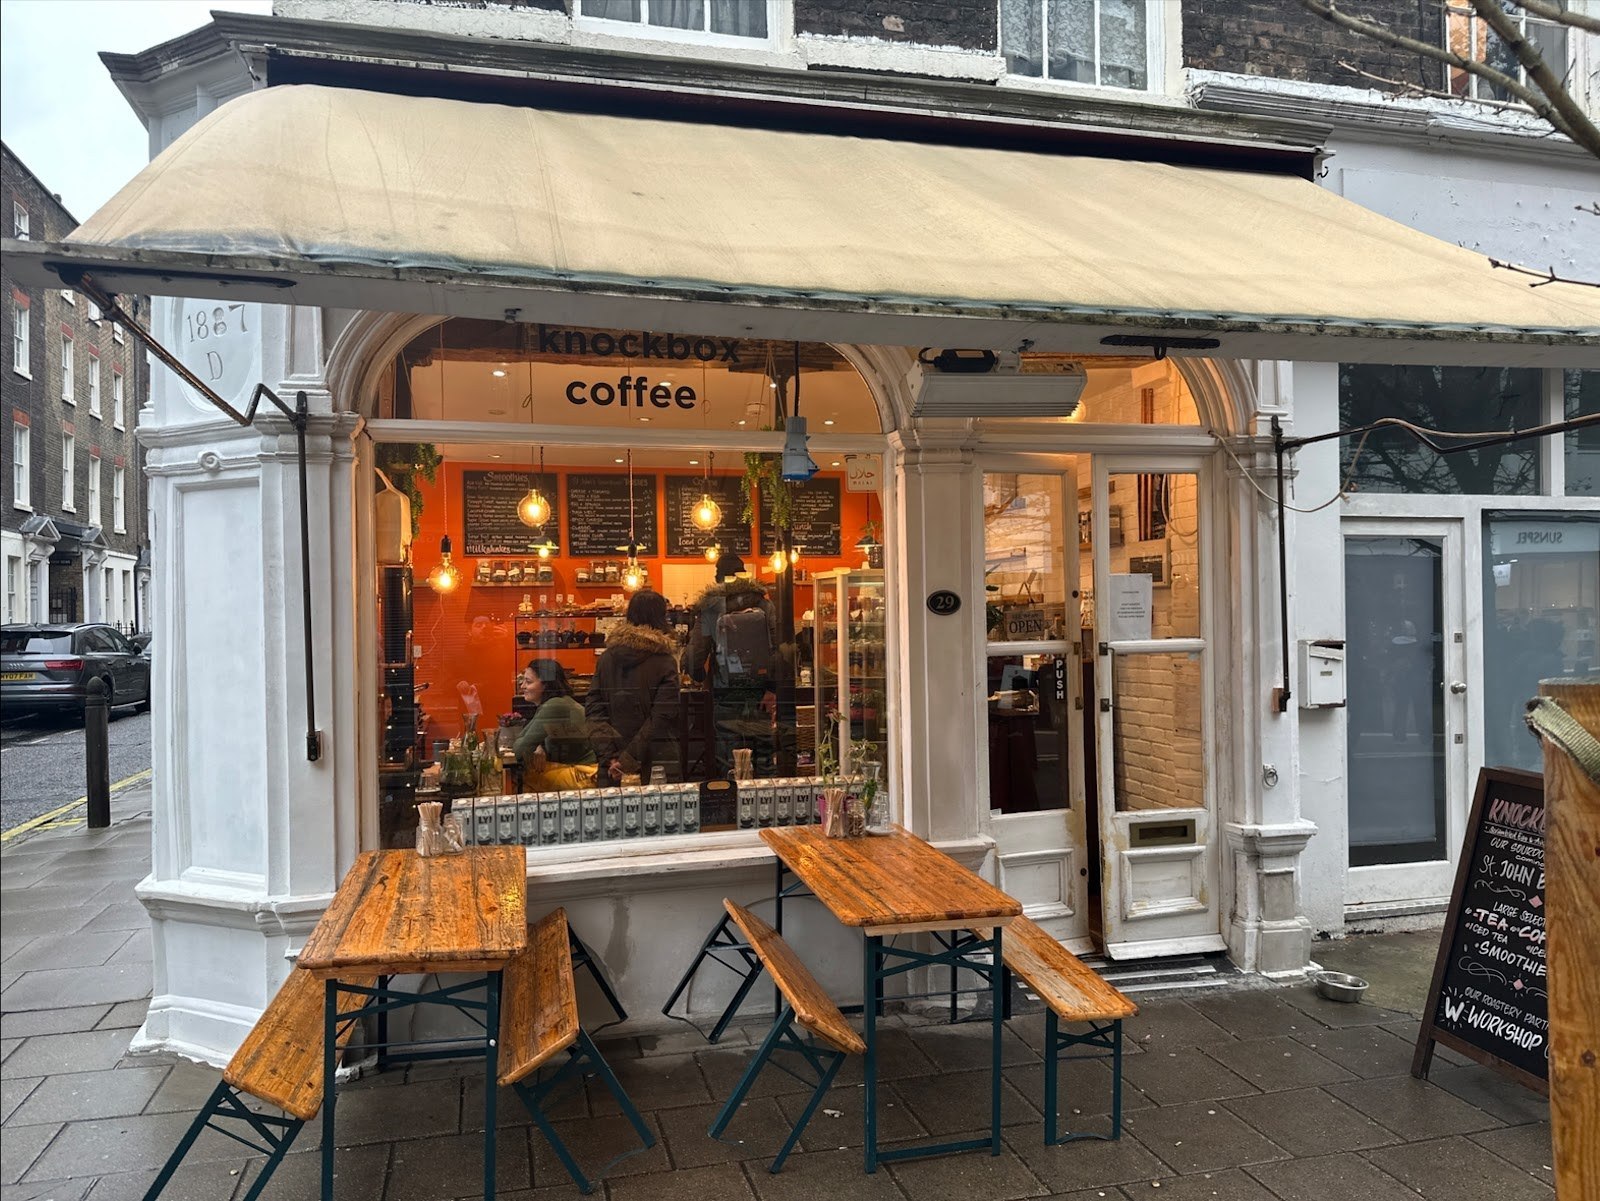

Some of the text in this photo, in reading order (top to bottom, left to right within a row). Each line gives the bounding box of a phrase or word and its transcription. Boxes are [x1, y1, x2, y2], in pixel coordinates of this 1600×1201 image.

[187, 303, 248, 343] 1887
[539, 324, 741, 363] knockbox
[206, 350, 223, 381] D
[566, 375, 697, 409] coffee
[935, 595, 955, 610] 29
[1009, 619, 1042, 634] OPEN
[1055, 659, 1064, 700] PUSH
[742, 797, 754, 805] LY!
[760, 796, 772, 804] LY!
[779, 795, 791, 803] LY!
[585, 807, 598, 815] LY!
[606, 806, 619, 814] LY!
[646, 803, 658, 811] LY!
[665, 802, 678, 810] LY!
[501, 814, 514, 822] LY!
[522, 812, 535, 820] LY!
[544, 811, 556, 819] LY!
[565, 809, 577, 817] LY!
[478, 816, 492, 824] LY!
[1490, 837, 1509, 849] OUR
[1479, 854, 1498, 877] St.
[1500, 860, 1535, 887] JOHN
[1493, 901, 1519, 918] LARGE
[1491, 931, 1508, 945] TEA
[1528, 945, 1546, 959] ICE
[1464, 986, 1482, 1001] OUR
[1482, 994, 1523, 1019] ROASTERY
[1445, 996, 1543, 1051] W WORKSHOP
